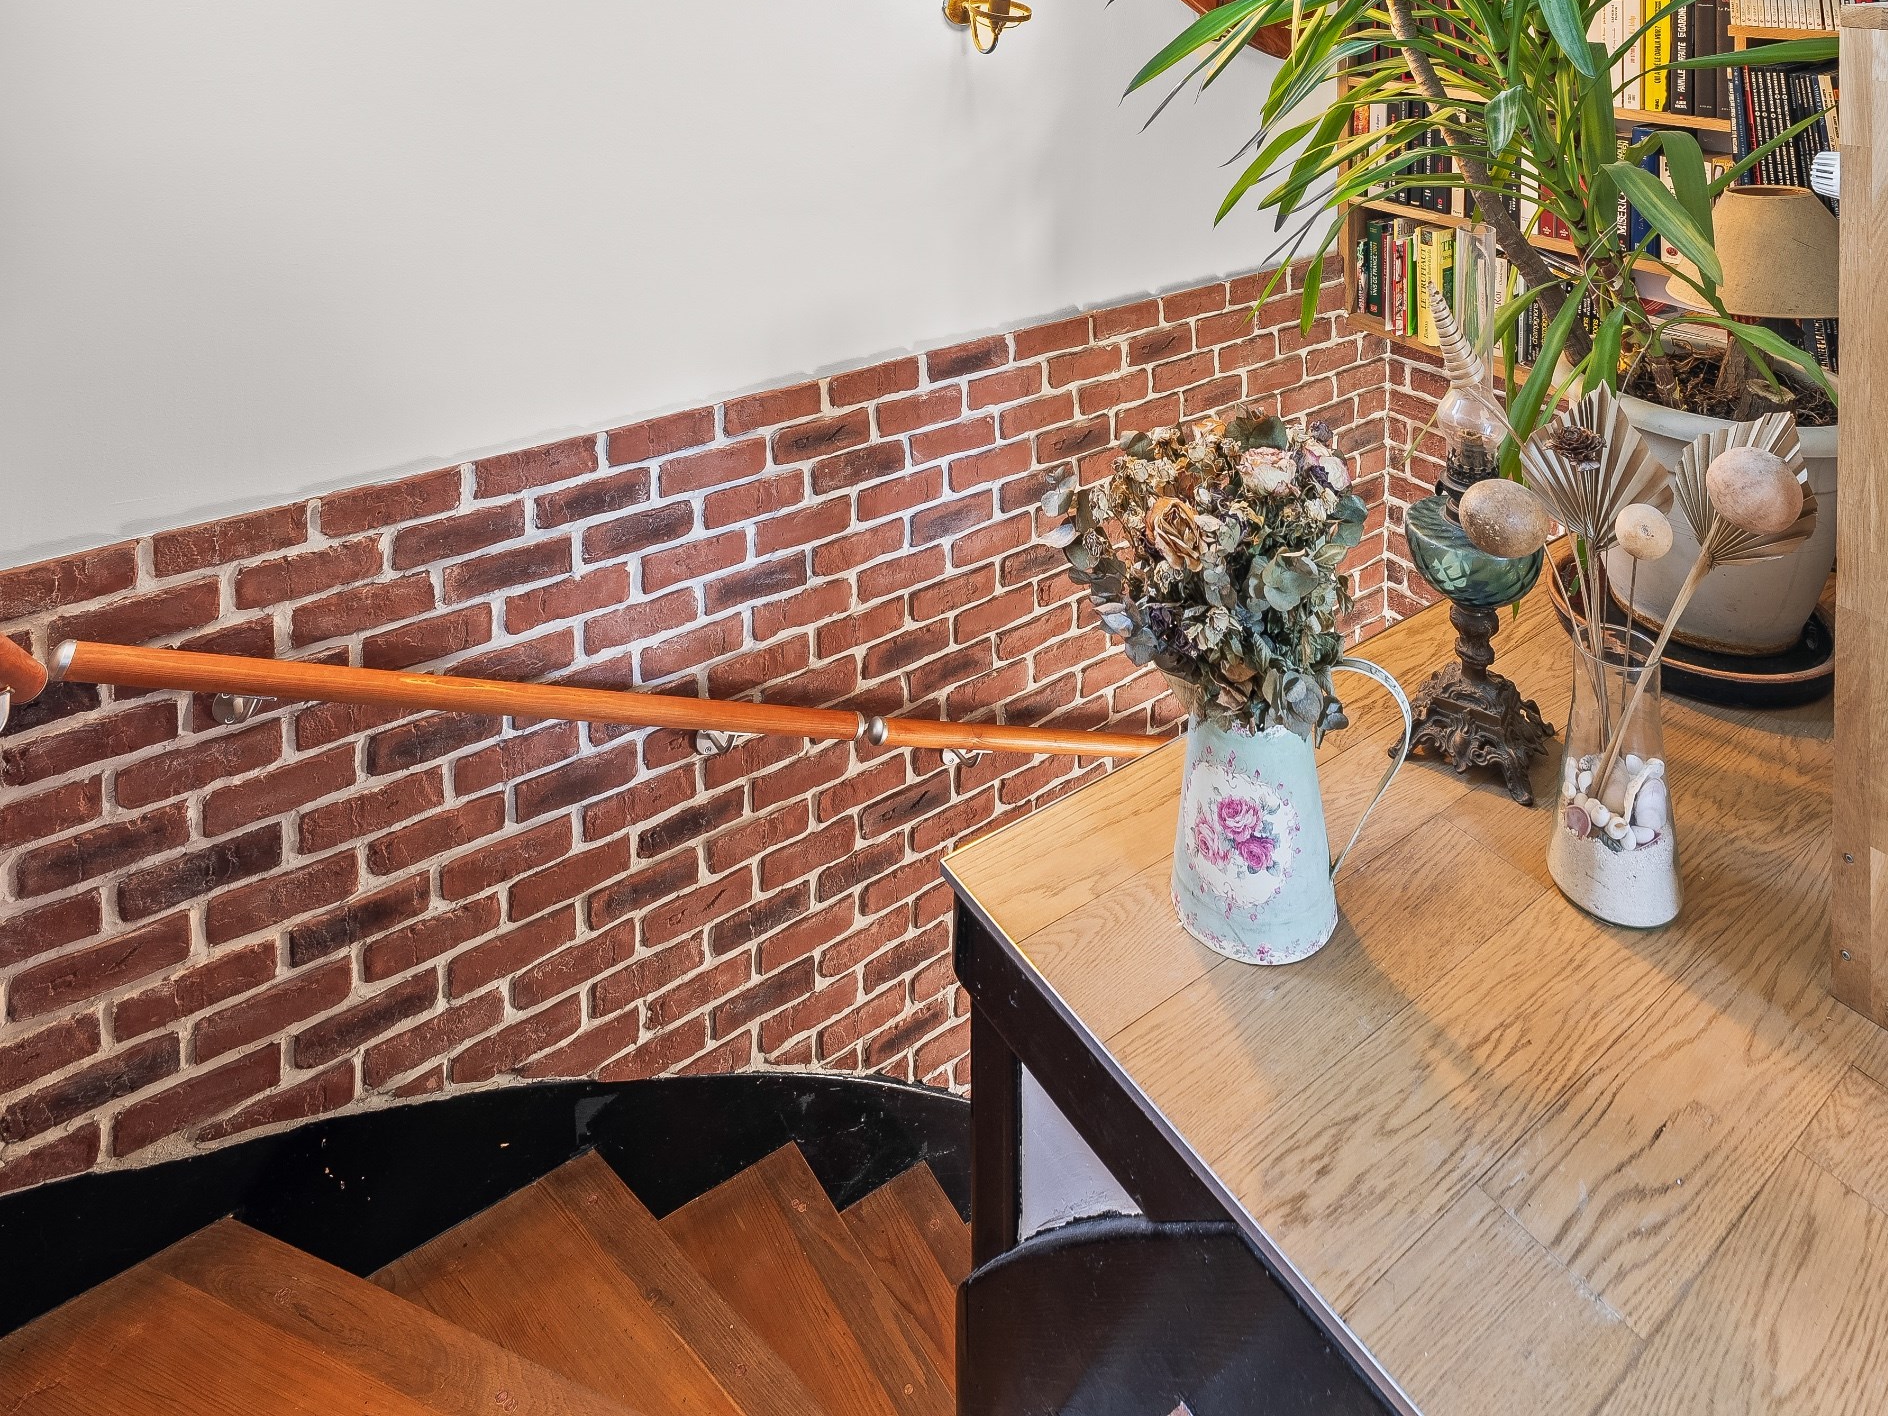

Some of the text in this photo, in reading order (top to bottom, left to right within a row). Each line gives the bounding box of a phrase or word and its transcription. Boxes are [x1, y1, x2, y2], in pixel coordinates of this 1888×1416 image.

[1677, 5, 1686, 31] GARDNE
[1677, 70, 1686, 93] FAMILLE
[1616, 191, 1627, 236] MISERIC
[1421, 297, 1427, 309] LE
